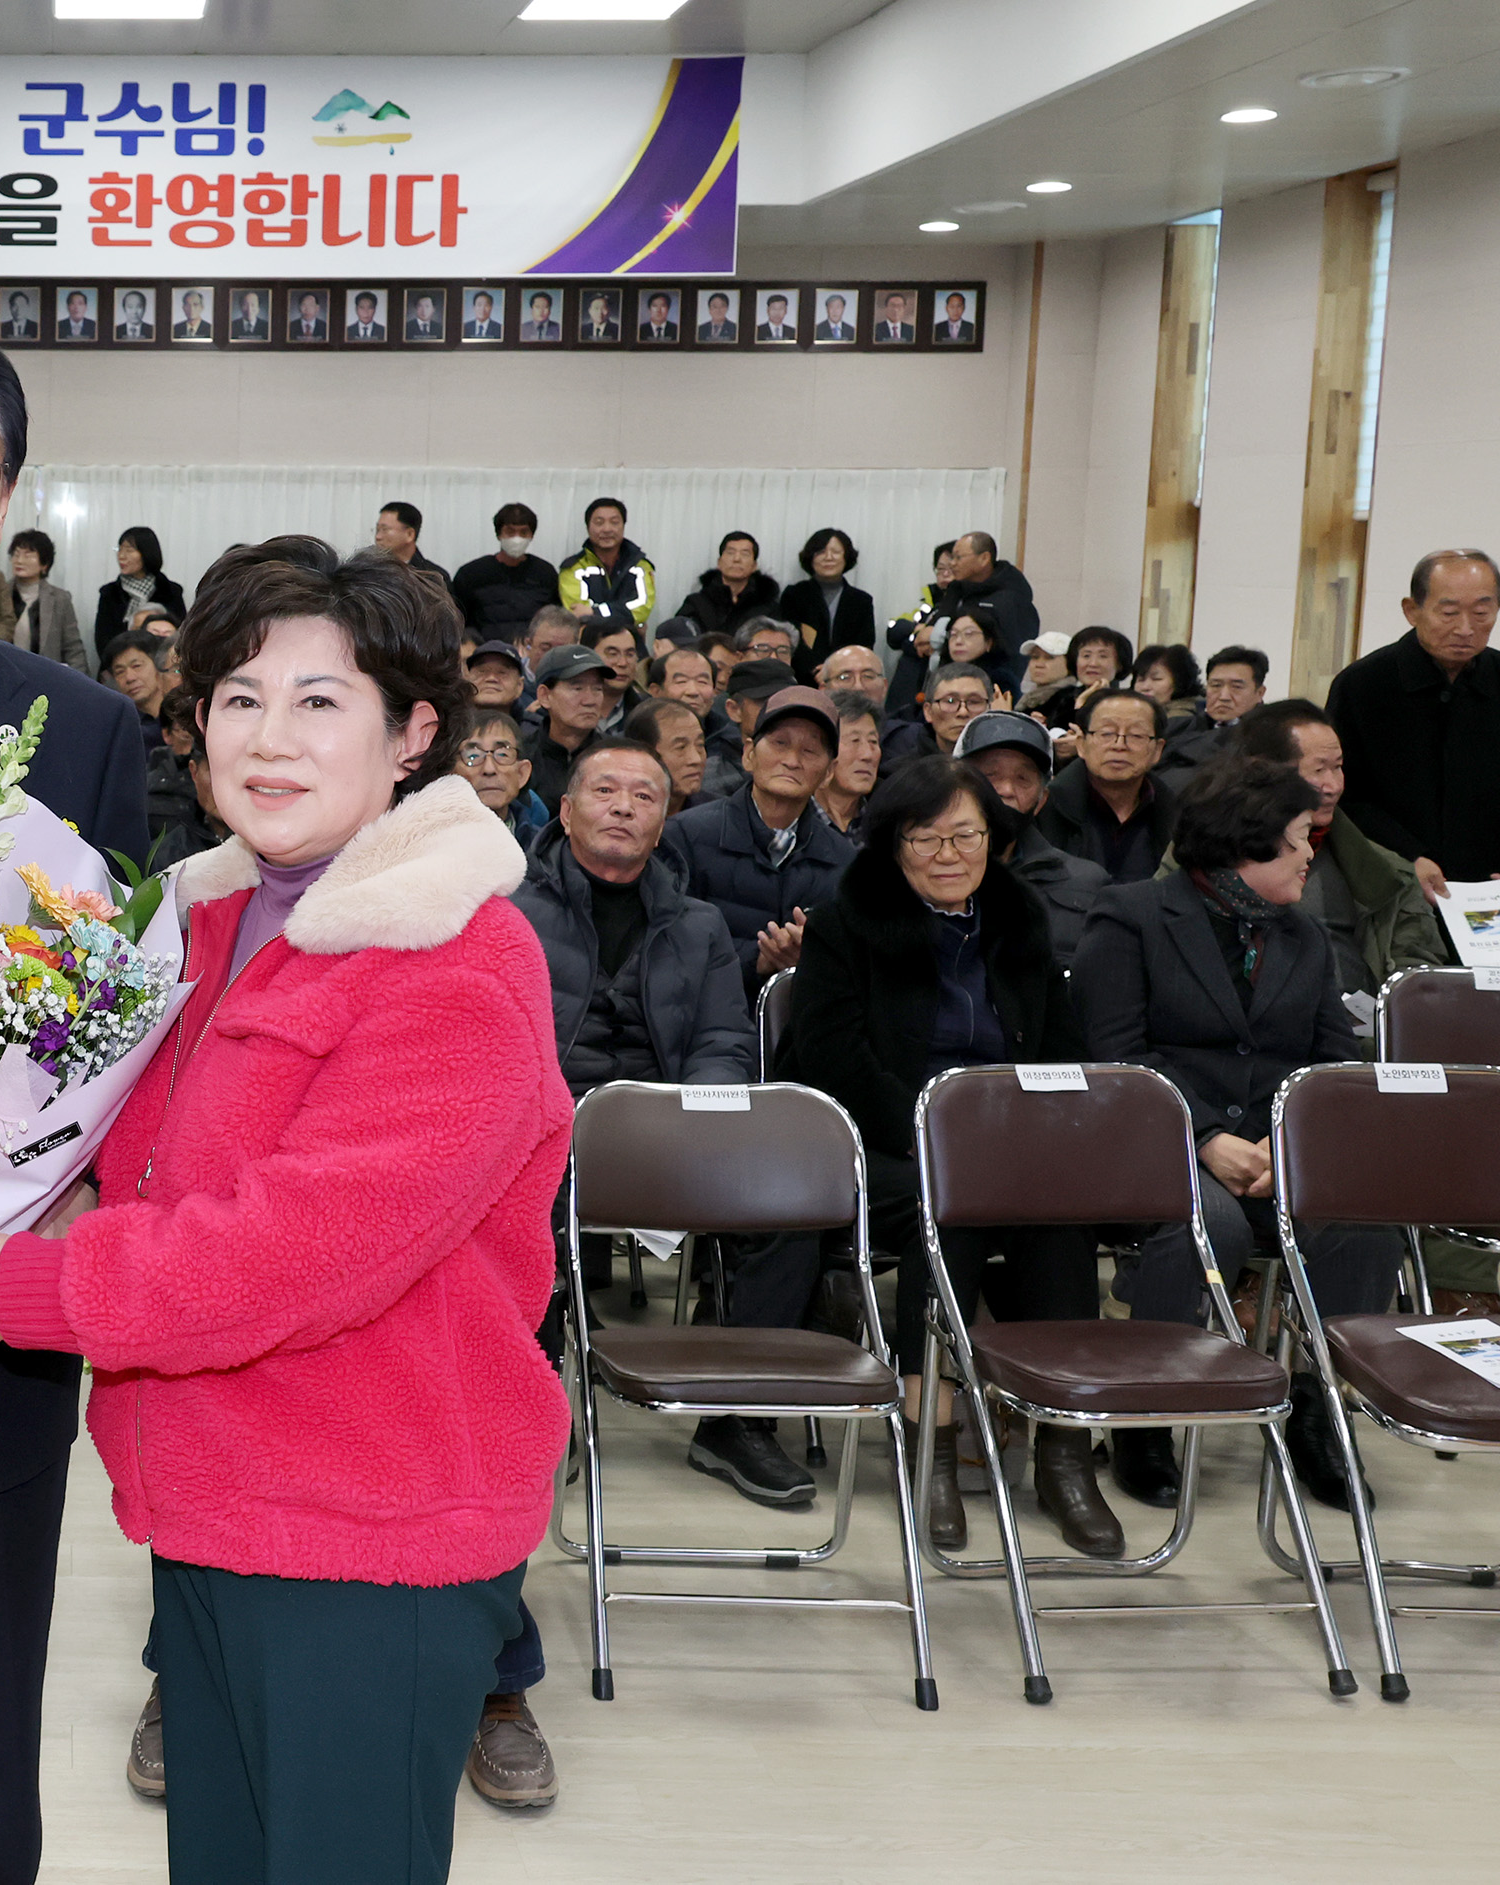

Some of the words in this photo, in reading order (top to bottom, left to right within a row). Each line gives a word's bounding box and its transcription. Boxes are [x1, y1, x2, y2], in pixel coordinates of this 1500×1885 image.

[18, 81, 266, 156] 군수님!
[88, 171, 468, 248] 환영합니다
[1022, 1070, 1082, 1080] 이장협의회장
[1381, 1068, 1441, 1079] 노인회부회장
